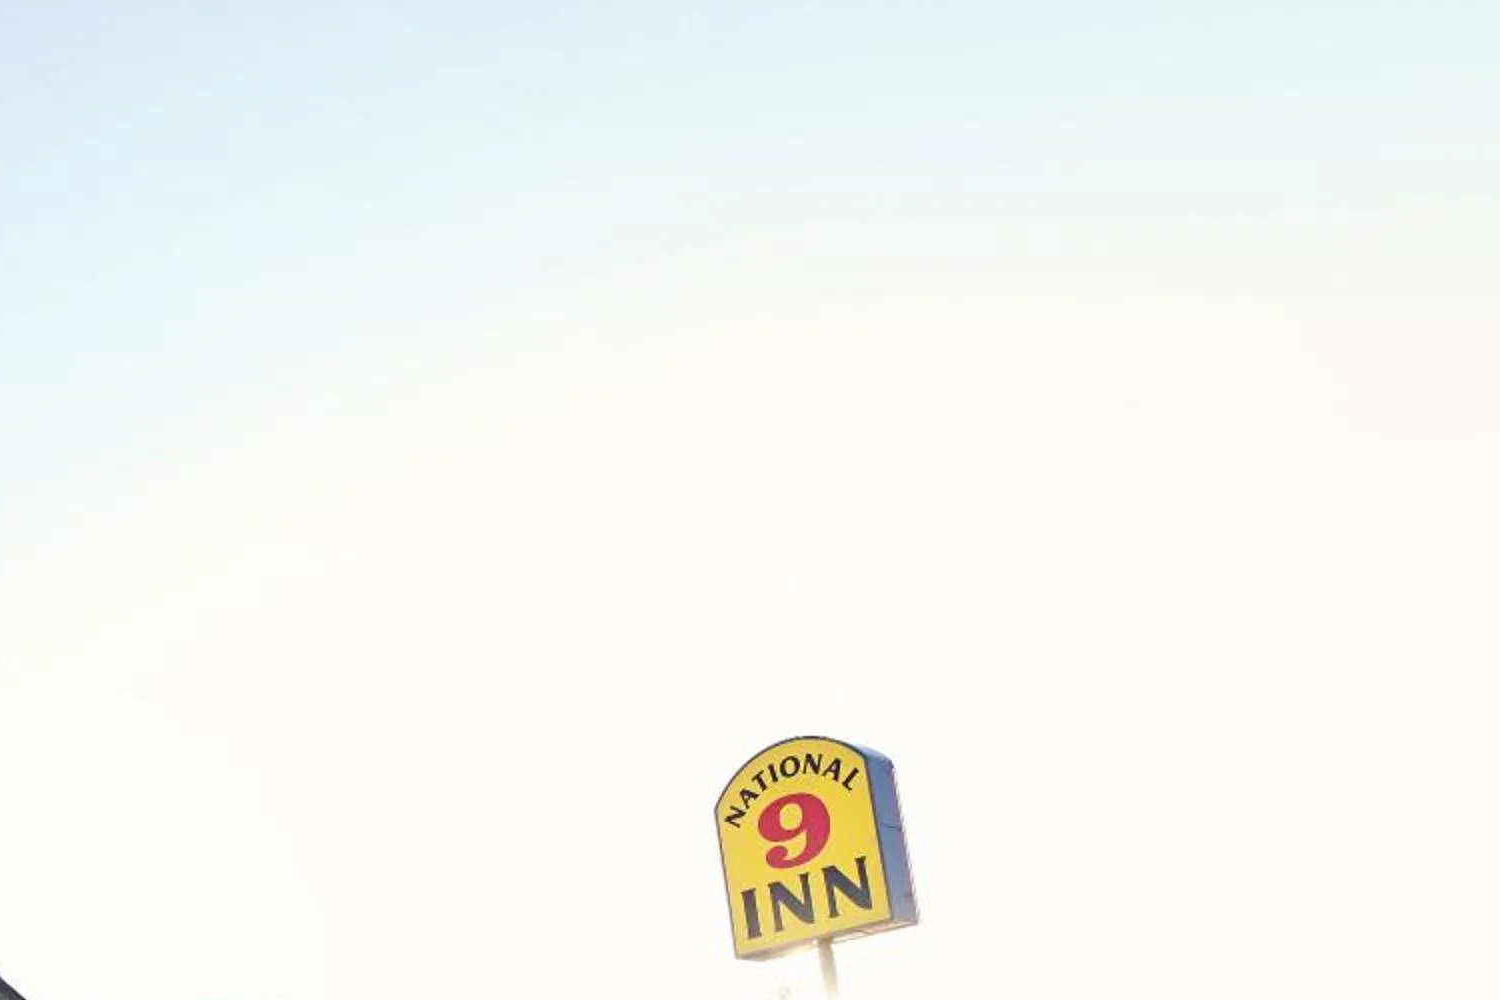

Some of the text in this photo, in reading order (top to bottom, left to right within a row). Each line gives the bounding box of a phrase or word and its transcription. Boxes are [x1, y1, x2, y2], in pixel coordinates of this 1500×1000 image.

[724, 752, 860, 829] NATIONAL
[757, 792, 831, 869] 9
[740, 856, 873, 940] INN
